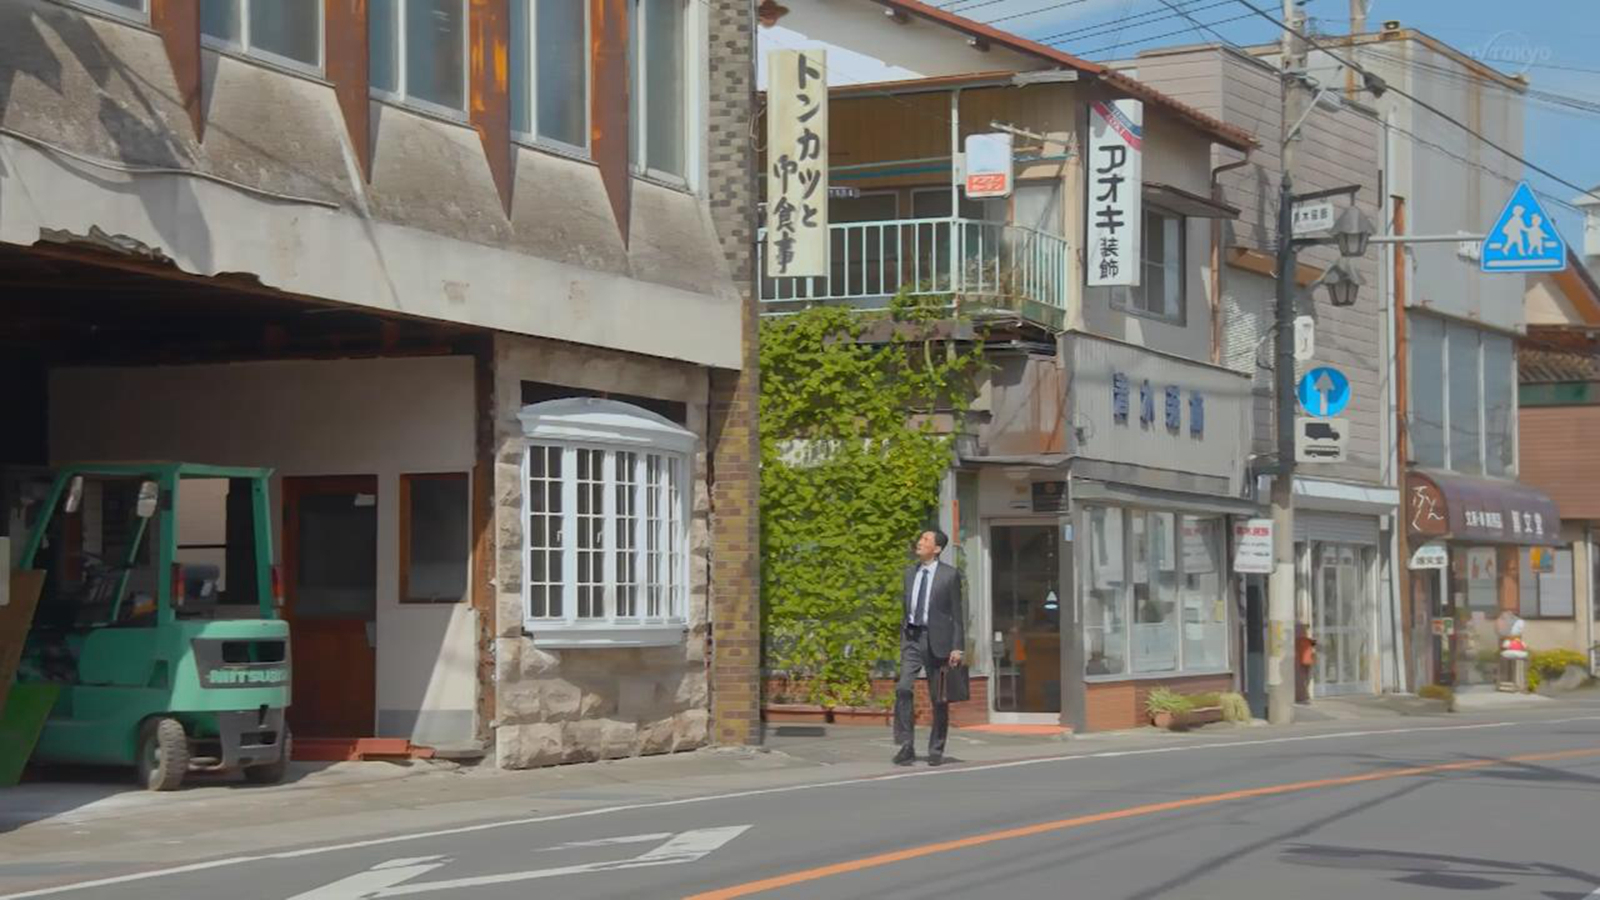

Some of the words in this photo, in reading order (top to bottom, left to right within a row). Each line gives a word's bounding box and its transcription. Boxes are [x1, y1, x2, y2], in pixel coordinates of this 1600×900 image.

[796, 52, 821, 229] トンカツと
[1095, 144, 1126, 281] アオキ装飾
